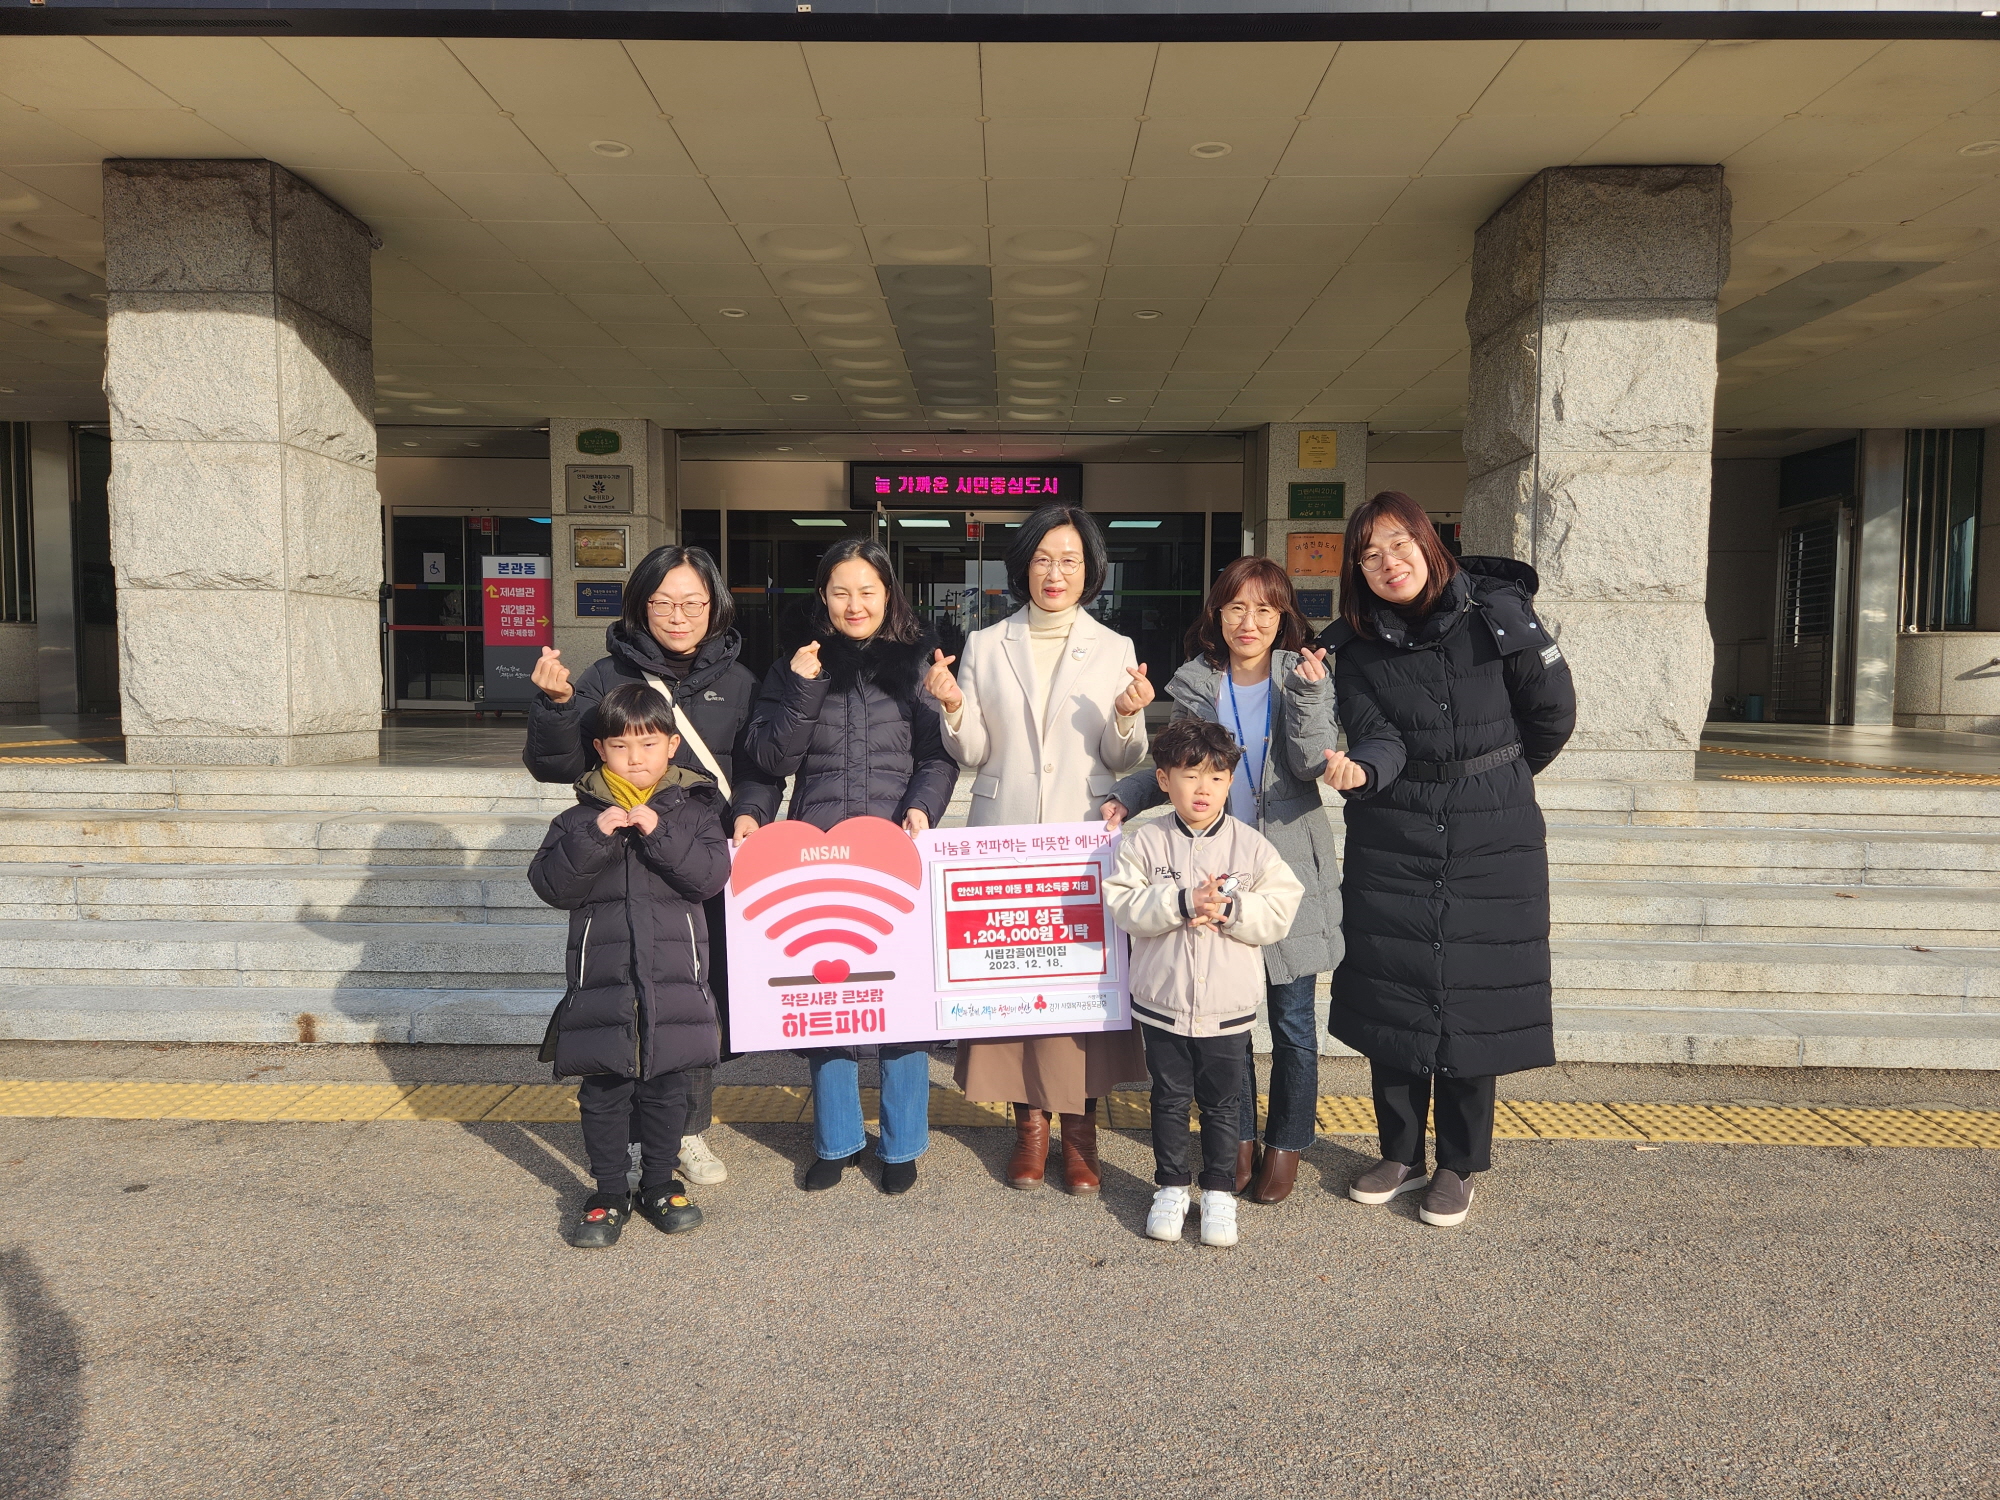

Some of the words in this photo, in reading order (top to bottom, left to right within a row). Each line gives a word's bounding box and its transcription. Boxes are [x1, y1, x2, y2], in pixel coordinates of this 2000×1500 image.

[874, 476, 891, 494] 늘
[898, 475, 949, 495] 가까운
[955, 476, 1058, 496] 시민중심도시
[497, 562, 536, 575] 본관동
[499, 586, 535, 598] 제4별관
[500, 604, 536, 615] 제2별관
[800, 845, 850, 862] ANSAN
[934, 840, 972, 857] 나눔을
[976, 837, 1027, 854] 전파하는
[1032, 835, 1070, 852] 따뜻한
[1075, 833, 1112, 849] 에너지
[957, 886, 983, 897] 안산시
[985, 885, 1003, 896] 취약
[1004, 884, 1022, 894] 아동
[1024, 883, 1033, 893] 및
[1035, 881, 1069, 893] 저소득층
[1072, 880, 1089, 891] 지원
[985, 909, 1030, 928] 사랑의
[1034, 908, 1065, 926] 성금
[963, 925, 1054, 945] 1,204,000원
[1059, 923, 1089, 941] 기탁
[984, 945, 1067, 960] 시립감골어린이집
[988, 961, 1020, 971] 2023.
[1024, 959, 1042, 969] 12.
[1046, 958, 1064, 968] 18.
[780, 990, 838, 1007] 작은사랑
[842, 988, 884, 1003] 큰보람
[1060, 1000, 1107, 1011] 사회복지공동모금회
[781, 1007, 886, 1038] 하트파이
